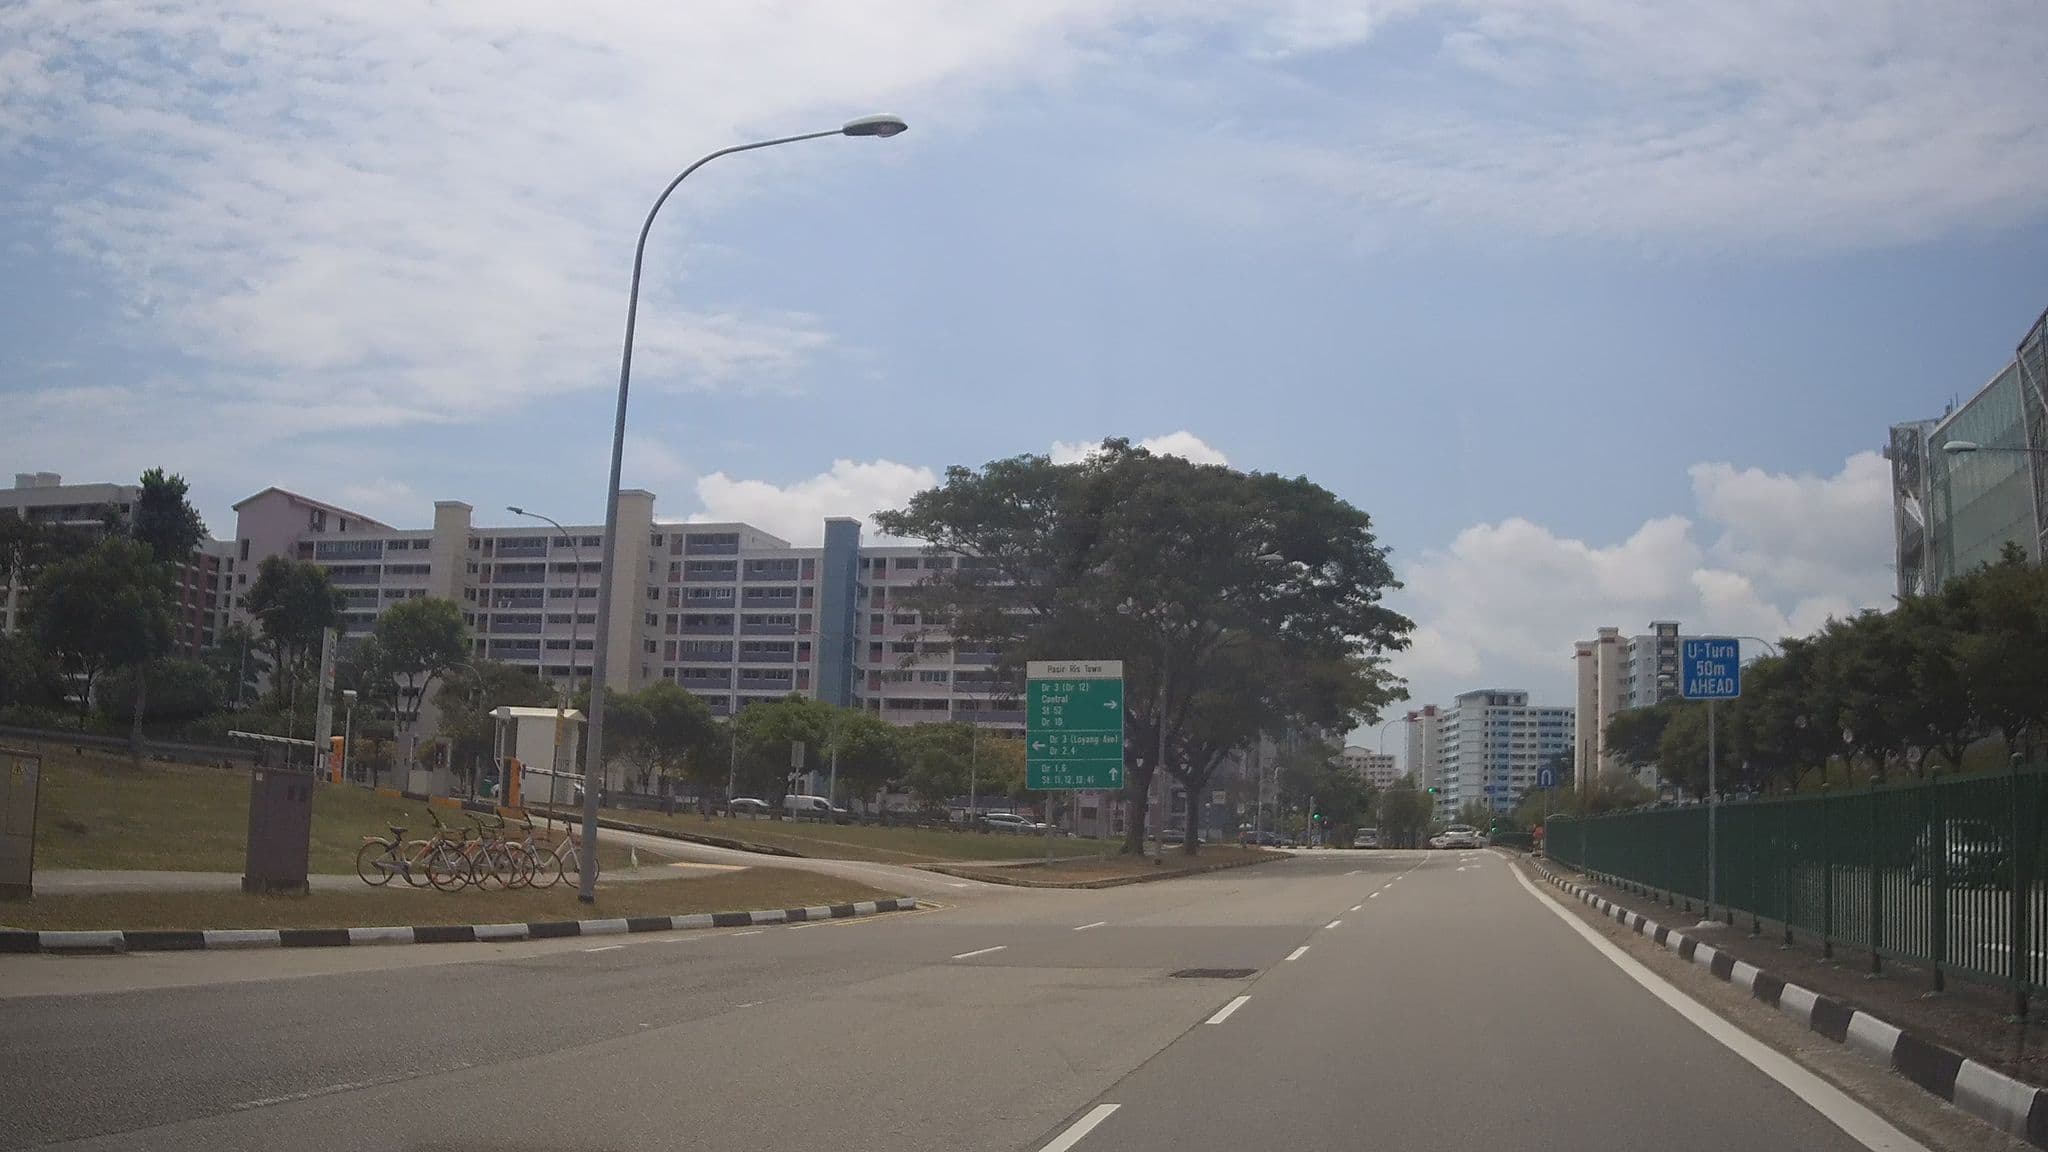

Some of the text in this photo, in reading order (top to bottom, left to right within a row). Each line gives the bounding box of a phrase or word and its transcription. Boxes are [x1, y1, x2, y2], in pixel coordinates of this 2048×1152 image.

[1688, 642, 1734, 658] U-Turn
[1085, 665, 1102, 673] Town
[1696, 660, 1725, 676] 50m
[1041, 683, 1050, 692] Dr
[1689, 678, 1734, 695] AHEAD
[1041, 694, 1069, 704] Central
[1041, 706, 1049, 715] St
[1041, 718, 1050, 726] Dr
[1049, 735, 1058, 744] Dr
[1070, 735, 1099, 745] (Loyang
[1103, 735, 1118, 744] Ave)
[1049, 747, 1058, 755] Dr
[1041, 764, 1050, 773] Dr
[1041, 775, 1050, 784] St
